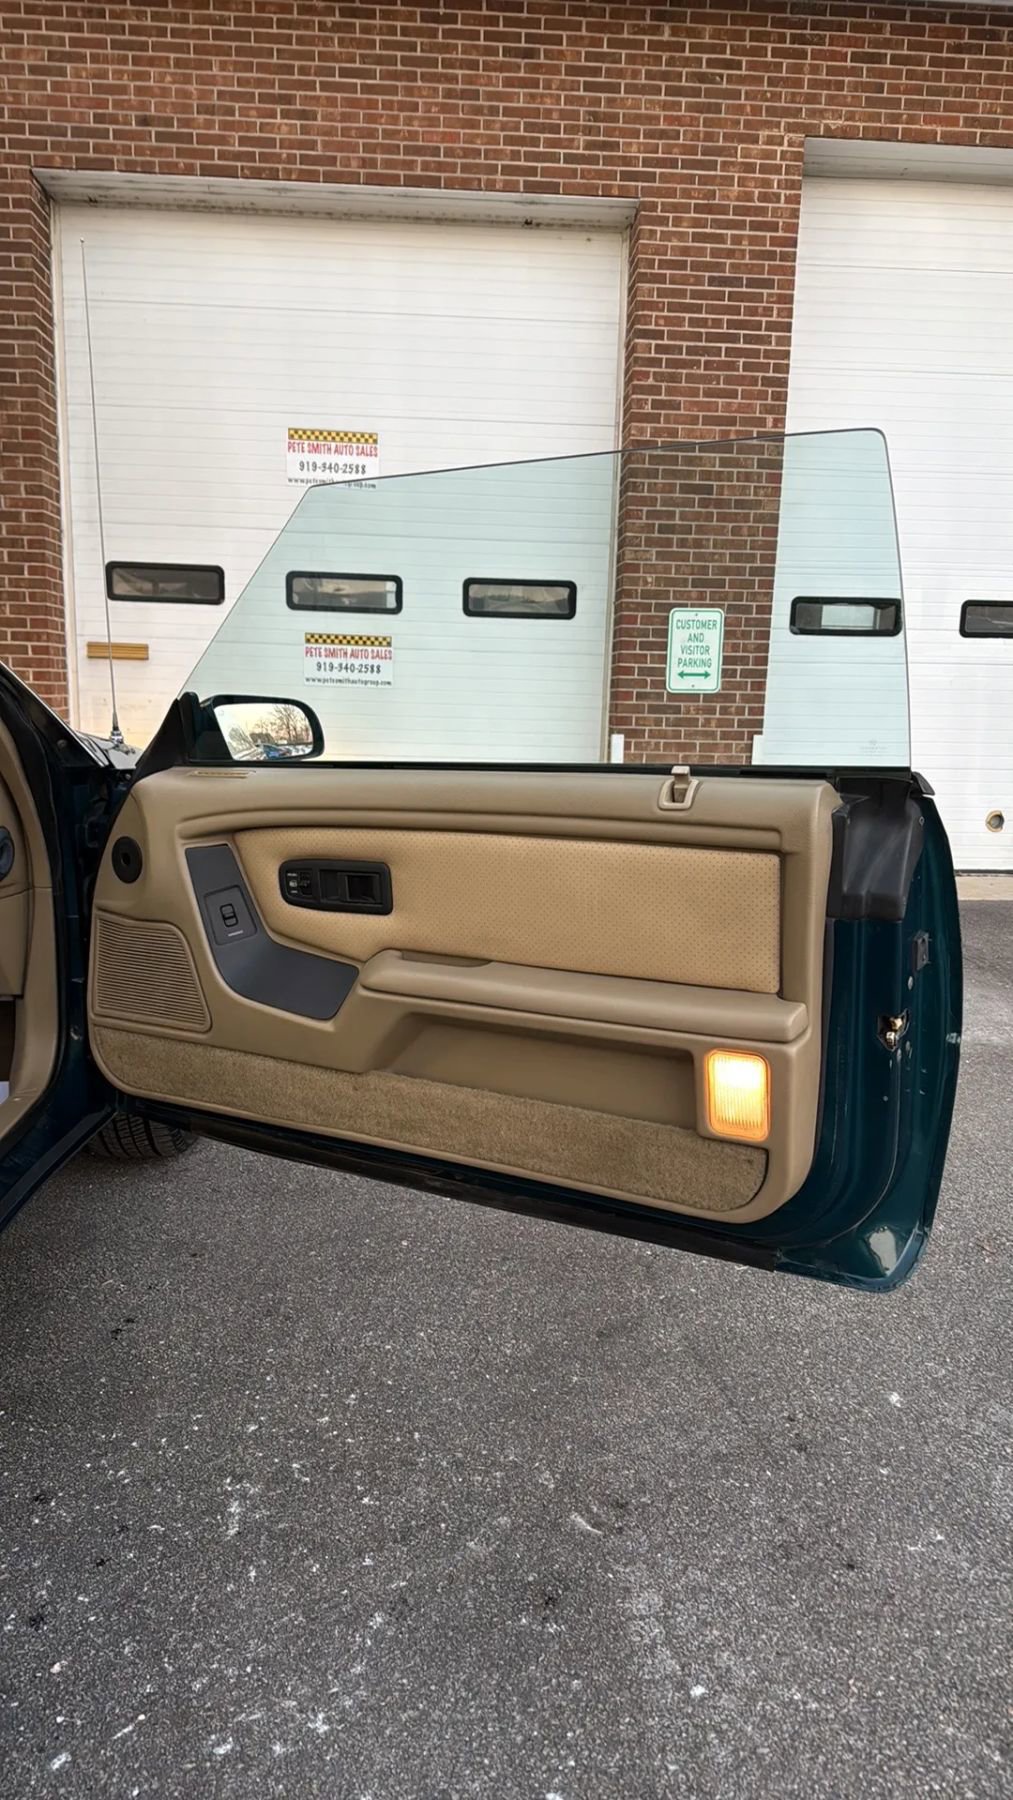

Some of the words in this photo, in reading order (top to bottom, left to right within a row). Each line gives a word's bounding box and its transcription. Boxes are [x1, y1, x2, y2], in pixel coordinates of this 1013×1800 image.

[288, 441, 305, 453] PETE
[308, 443, 332, 454] SMITH
[334, 444, 354, 456] AUTO
[356, 446, 378, 457] SALES
[676, 620, 717, 630] CUSTOMER
[688, 633, 704, 643] AND
[305, 646, 322, 657] PETE
[324, 648, 347, 658] SMITH
[350, 648, 369, 659] AUTO
[370, 649, 392, 660] SALES
[680, 645, 710, 655] VISITOR
[678, 658, 711, 668] PARKING
